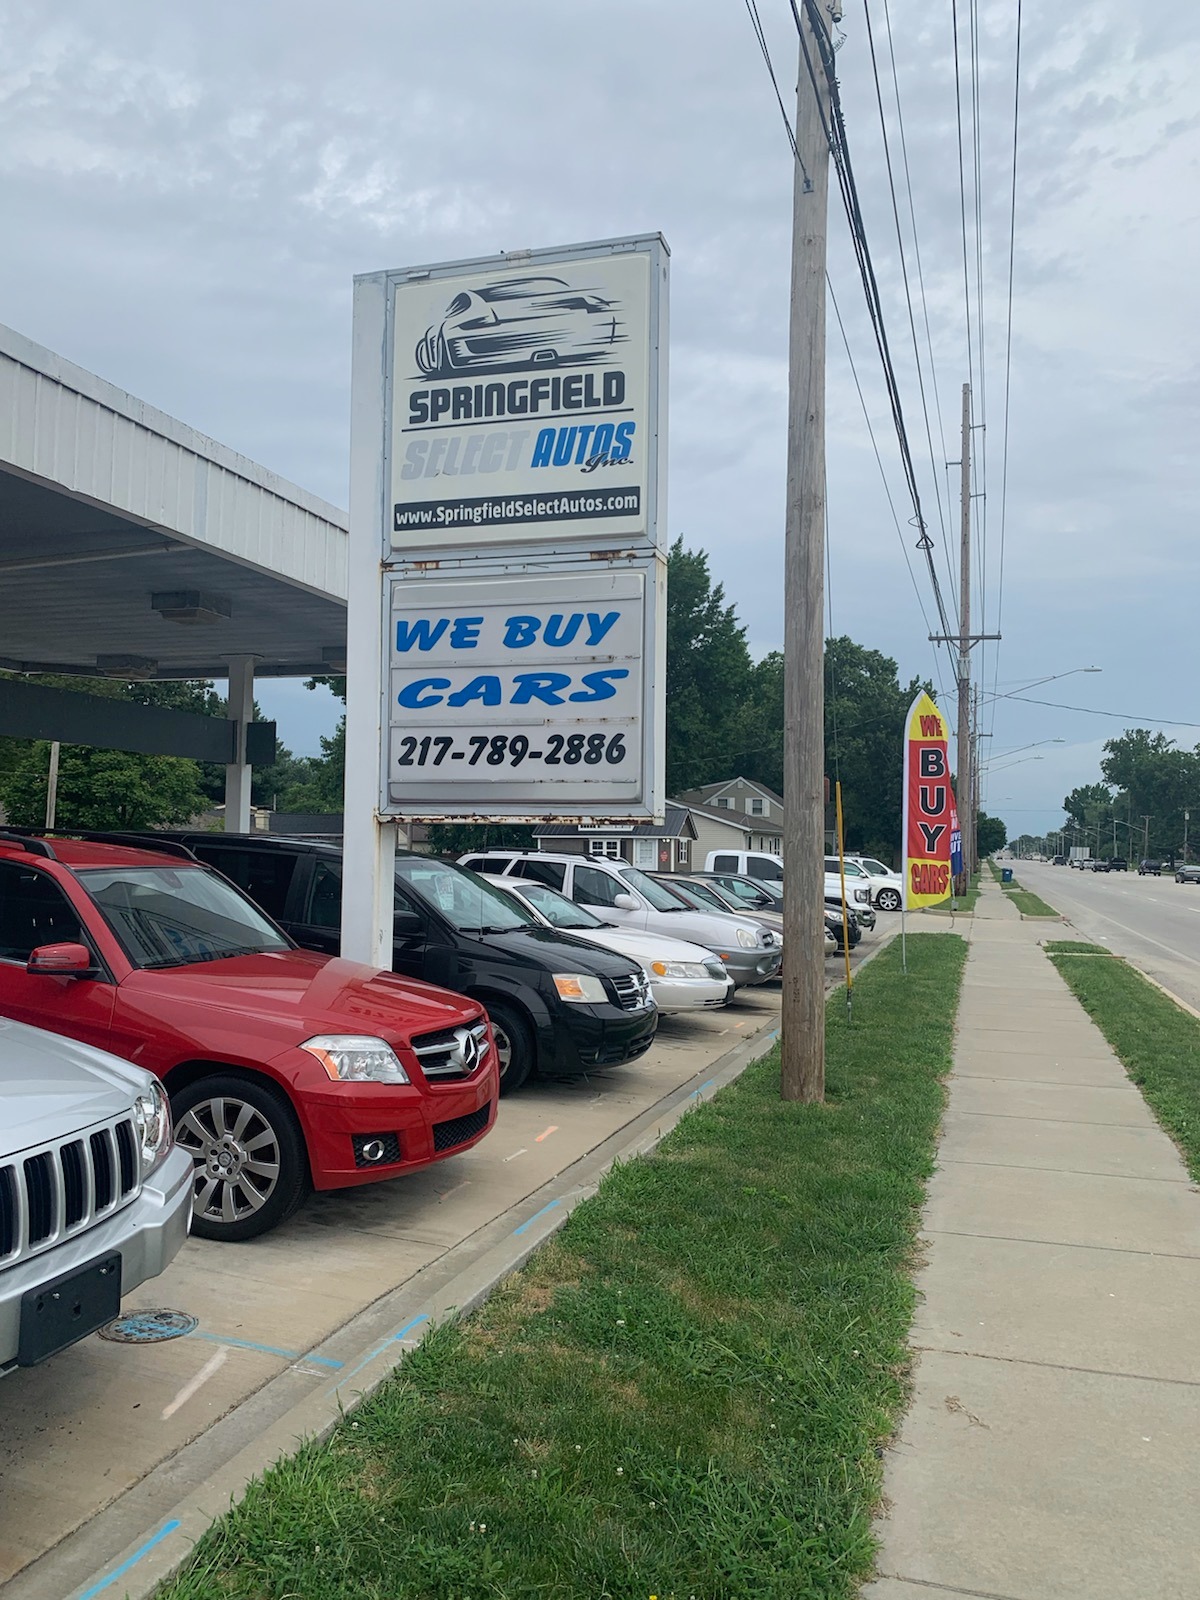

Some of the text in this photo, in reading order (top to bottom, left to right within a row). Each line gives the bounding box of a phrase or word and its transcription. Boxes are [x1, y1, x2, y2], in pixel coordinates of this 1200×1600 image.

[409, 371, 625, 424] SPRINGFIELD
[400, 421, 636, 480] SELECT AUTOS
[580, 452, 634, 473] Inc.
[396, 494, 638, 524] www.SpringfieldSelectAutos.com
[396, 612, 621, 652] WE BUY
[397, 669, 630, 709] CARS
[919, 715, 943, 737] WE
[398, 733, 626, 767] 217-789-2886
[919, 747, 947, 854] BUY
[950, 840, 962, 854] UT
[911, 863, 950, 895] CARS
